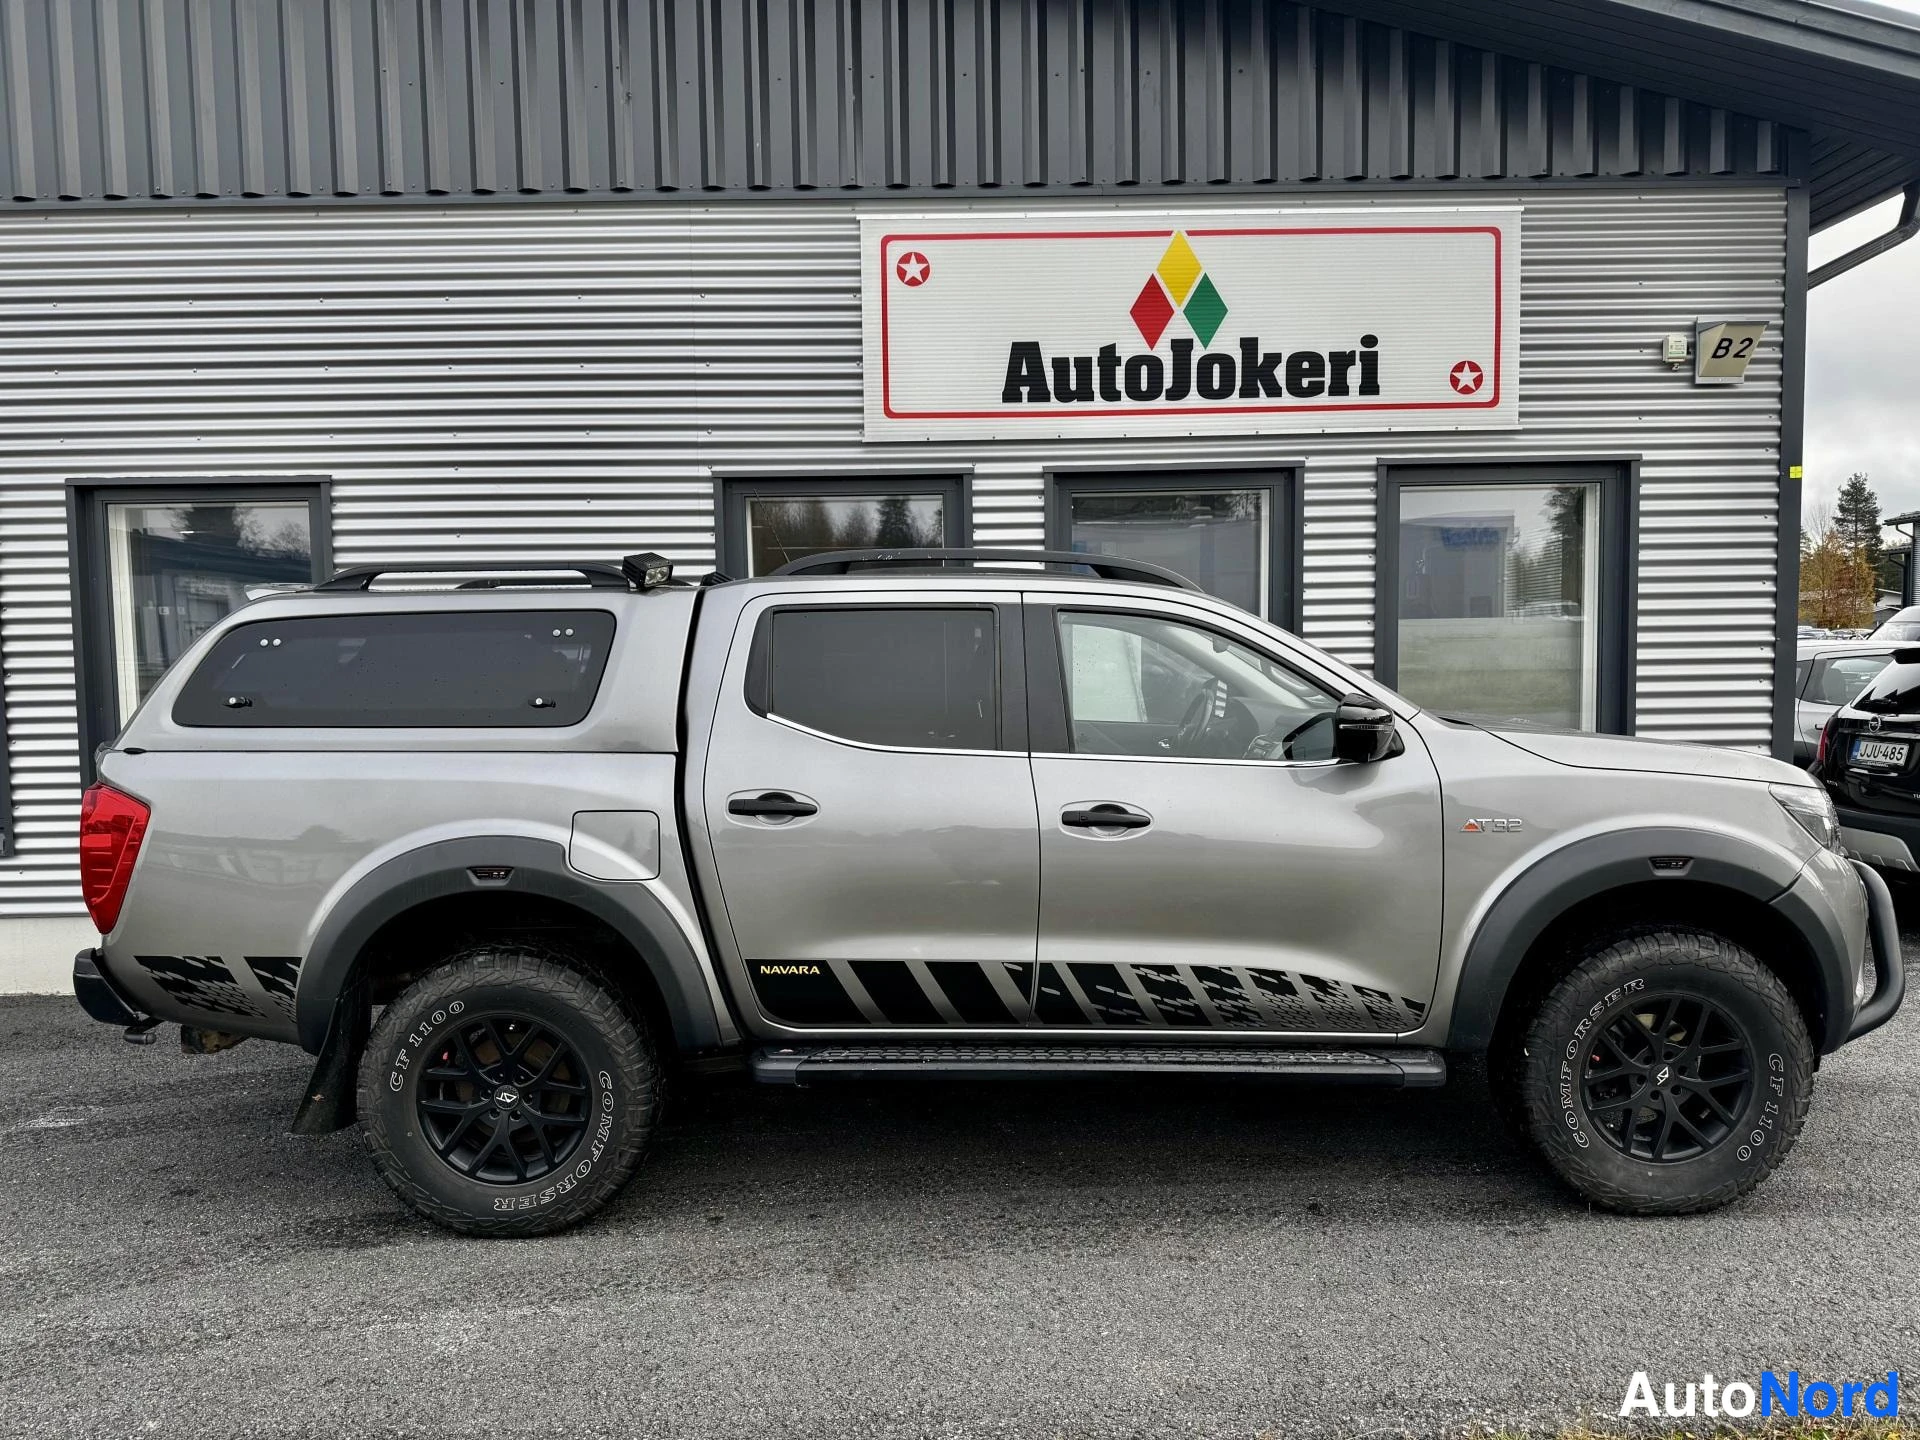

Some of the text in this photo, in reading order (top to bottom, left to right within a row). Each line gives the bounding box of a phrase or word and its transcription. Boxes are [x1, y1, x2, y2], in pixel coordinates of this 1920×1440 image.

[1001, 334, 1380, 404] AutoJokeri
[1859, 743, 1904, 761] JJU-485
[760, 965, 821, 975] NAVARA
[1560, 978, 1645, 1148] COMFORSER
[493, 1070, 614, 1211] COMFORSER
